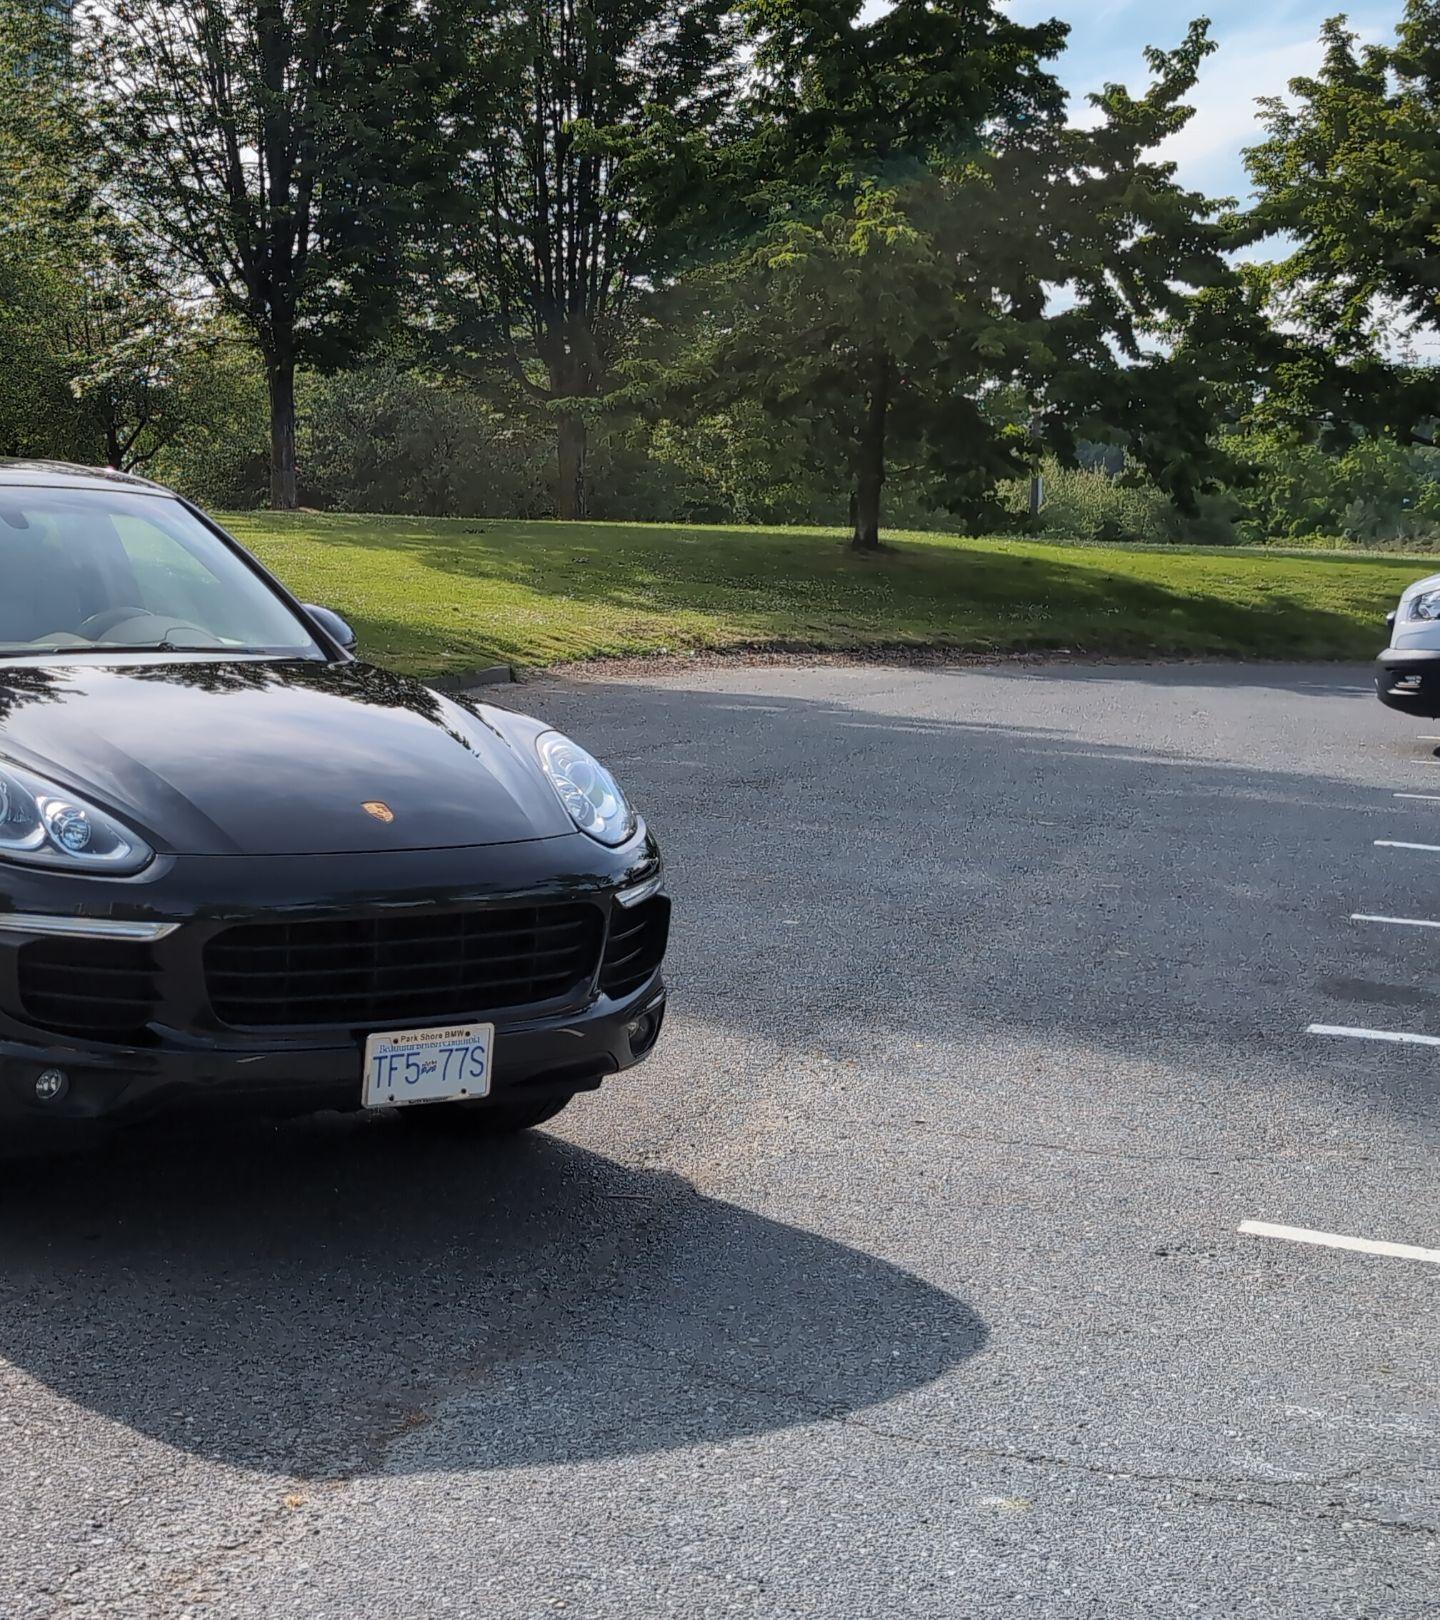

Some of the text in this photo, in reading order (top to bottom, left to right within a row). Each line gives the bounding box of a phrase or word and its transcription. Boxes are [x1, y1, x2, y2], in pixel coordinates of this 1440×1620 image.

[420, 1032, 443, 1041] Shore
[445, 1029, 465, 1038] BMW
[373, 1052, 421, 1089] TF5
[439, 1045, 485, 1081] 77S
